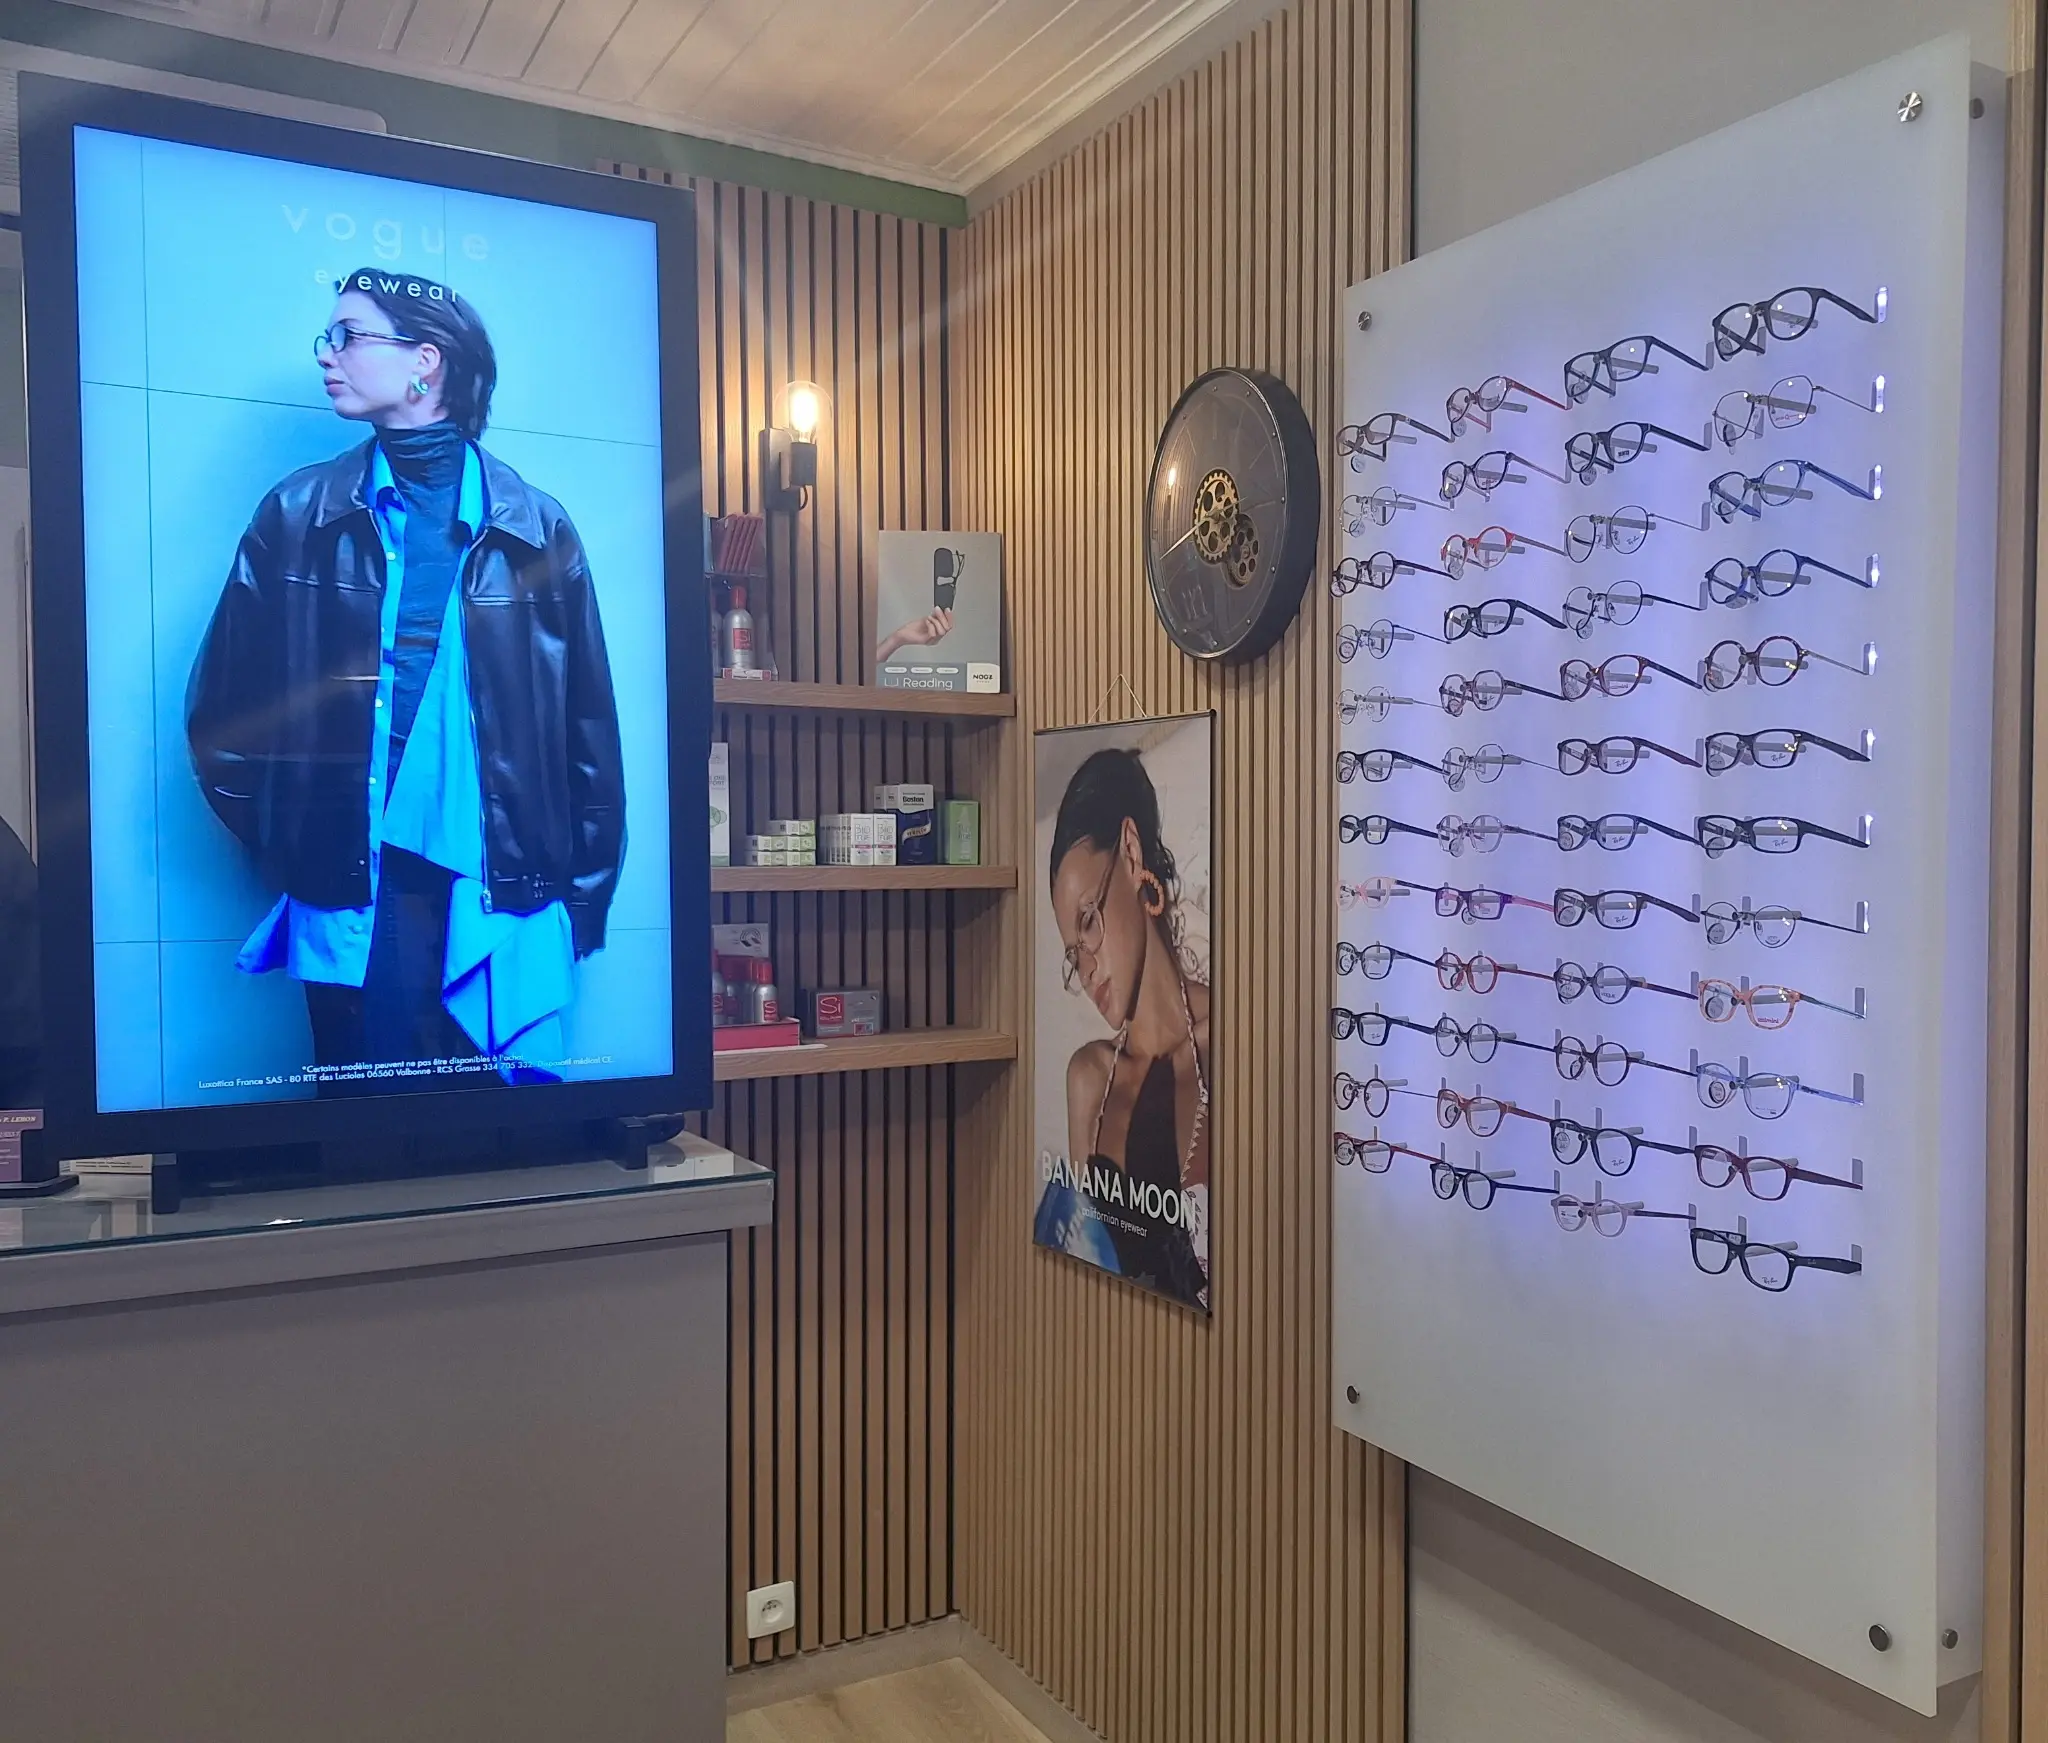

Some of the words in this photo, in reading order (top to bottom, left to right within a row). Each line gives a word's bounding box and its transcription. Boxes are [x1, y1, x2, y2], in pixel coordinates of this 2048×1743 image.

[281, 204, 489, 261] vogue
[314, 269, 459, 303] eyewear
[903, 677, 953, 691] Reading
[902, 795, 924, 803] Boston
[820, 996, 841, 1014] Si
[417, 1060, 432, 1068] pas
[449, 1055, 490, 1066] disponibles
[236, 1078, 264, 1087] France
[265, 1075, 283, 1085] SAS
[303, 1074, 317, 1082] RTE
[318, 1073, 333, 1081] des
[366, 1069, 395, 1079] 06560
[396, 1068, 431, 1077] Valbonne
[437, 1065, 453, 1074] RCS
[454, 1065, 481, 1073] Grasse
[482, 1063, 498, 1071] 334
[1042, 1150, 1125, 1207] BANANA
[1129, 1176, 1196, 1232] MOON
[1081, 1206, 1120, 1227] californian
[1120, 1217, 1148, 1238] eyewear
